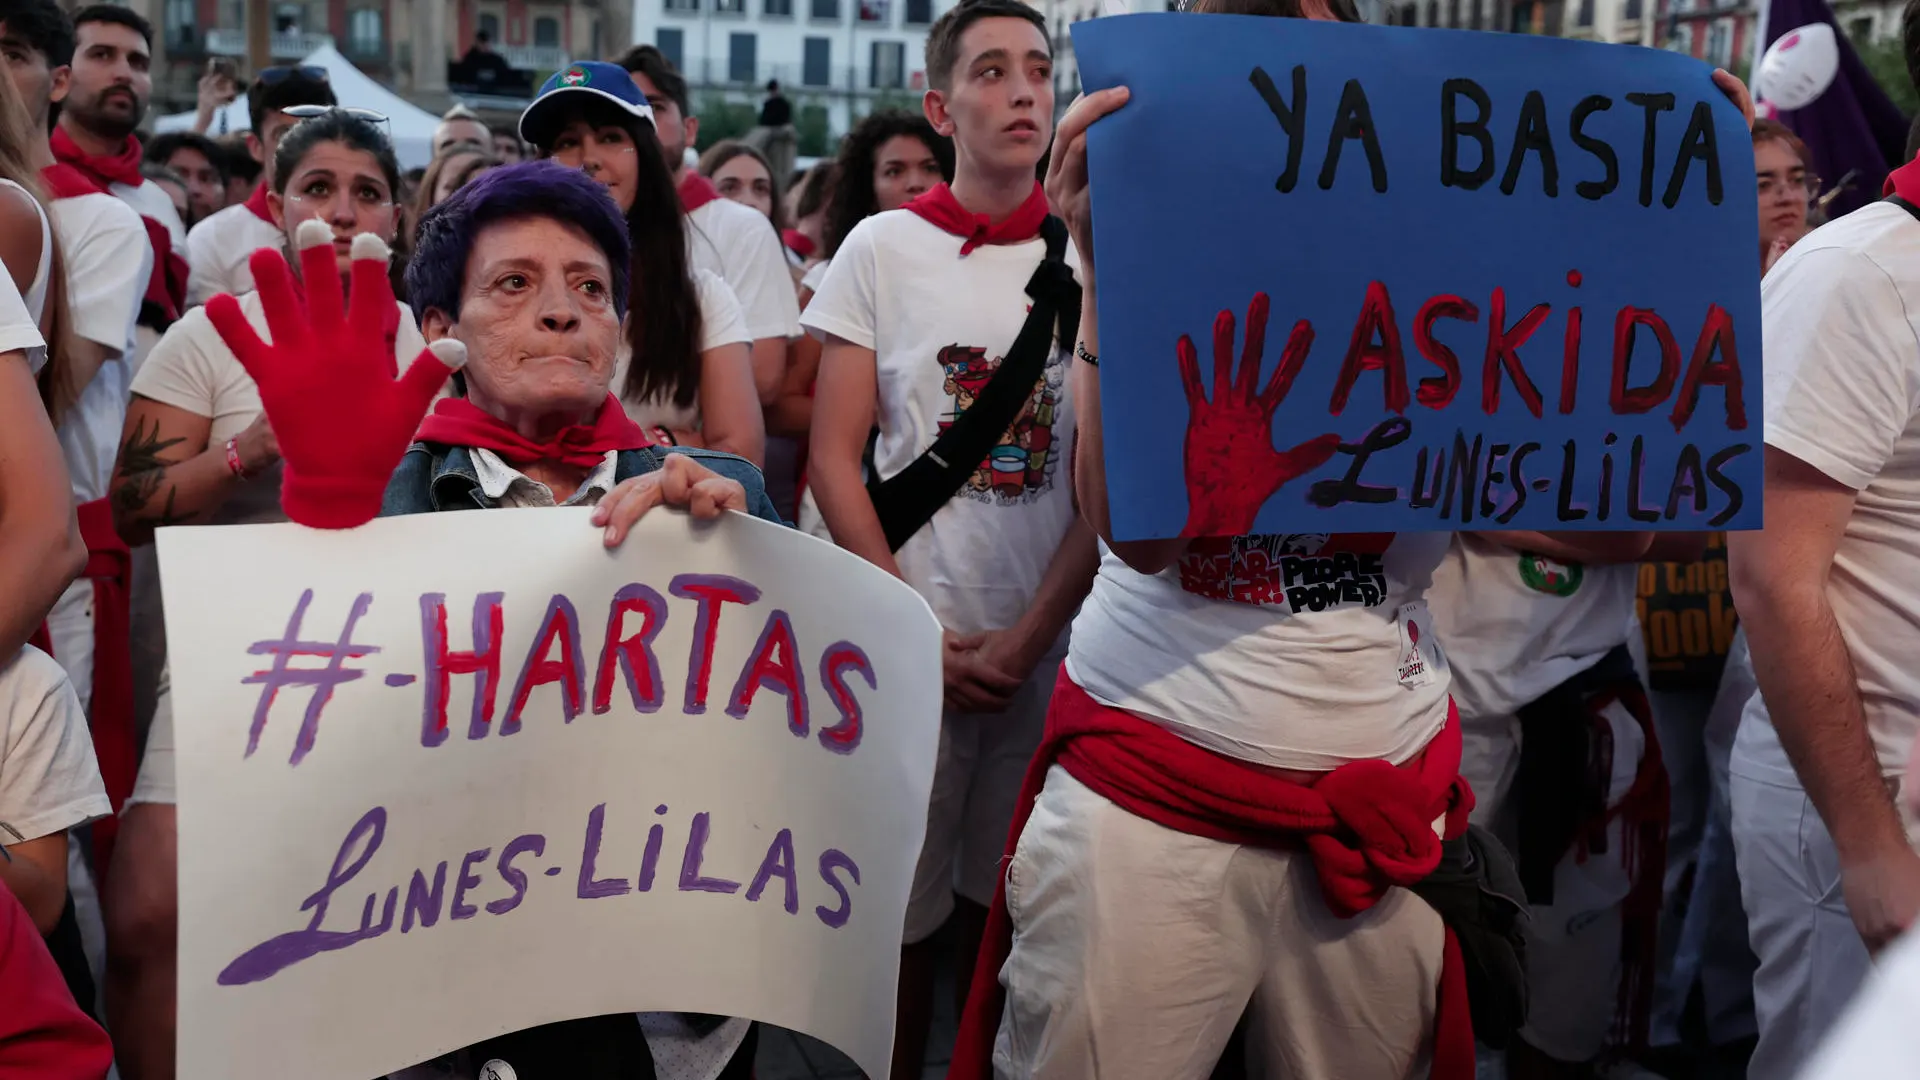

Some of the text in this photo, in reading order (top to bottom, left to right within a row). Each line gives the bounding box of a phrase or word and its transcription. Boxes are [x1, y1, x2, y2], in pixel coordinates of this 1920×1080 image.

[1248, 64, 1724, 209] YA BASTA
[1280, 552, 1384, 588] PEOPLE
[1286, 573, 1388, 614] POWER!
[1636, 592, 1738, 658] ook
[242, 573, 879, 767] #-HARTAS
